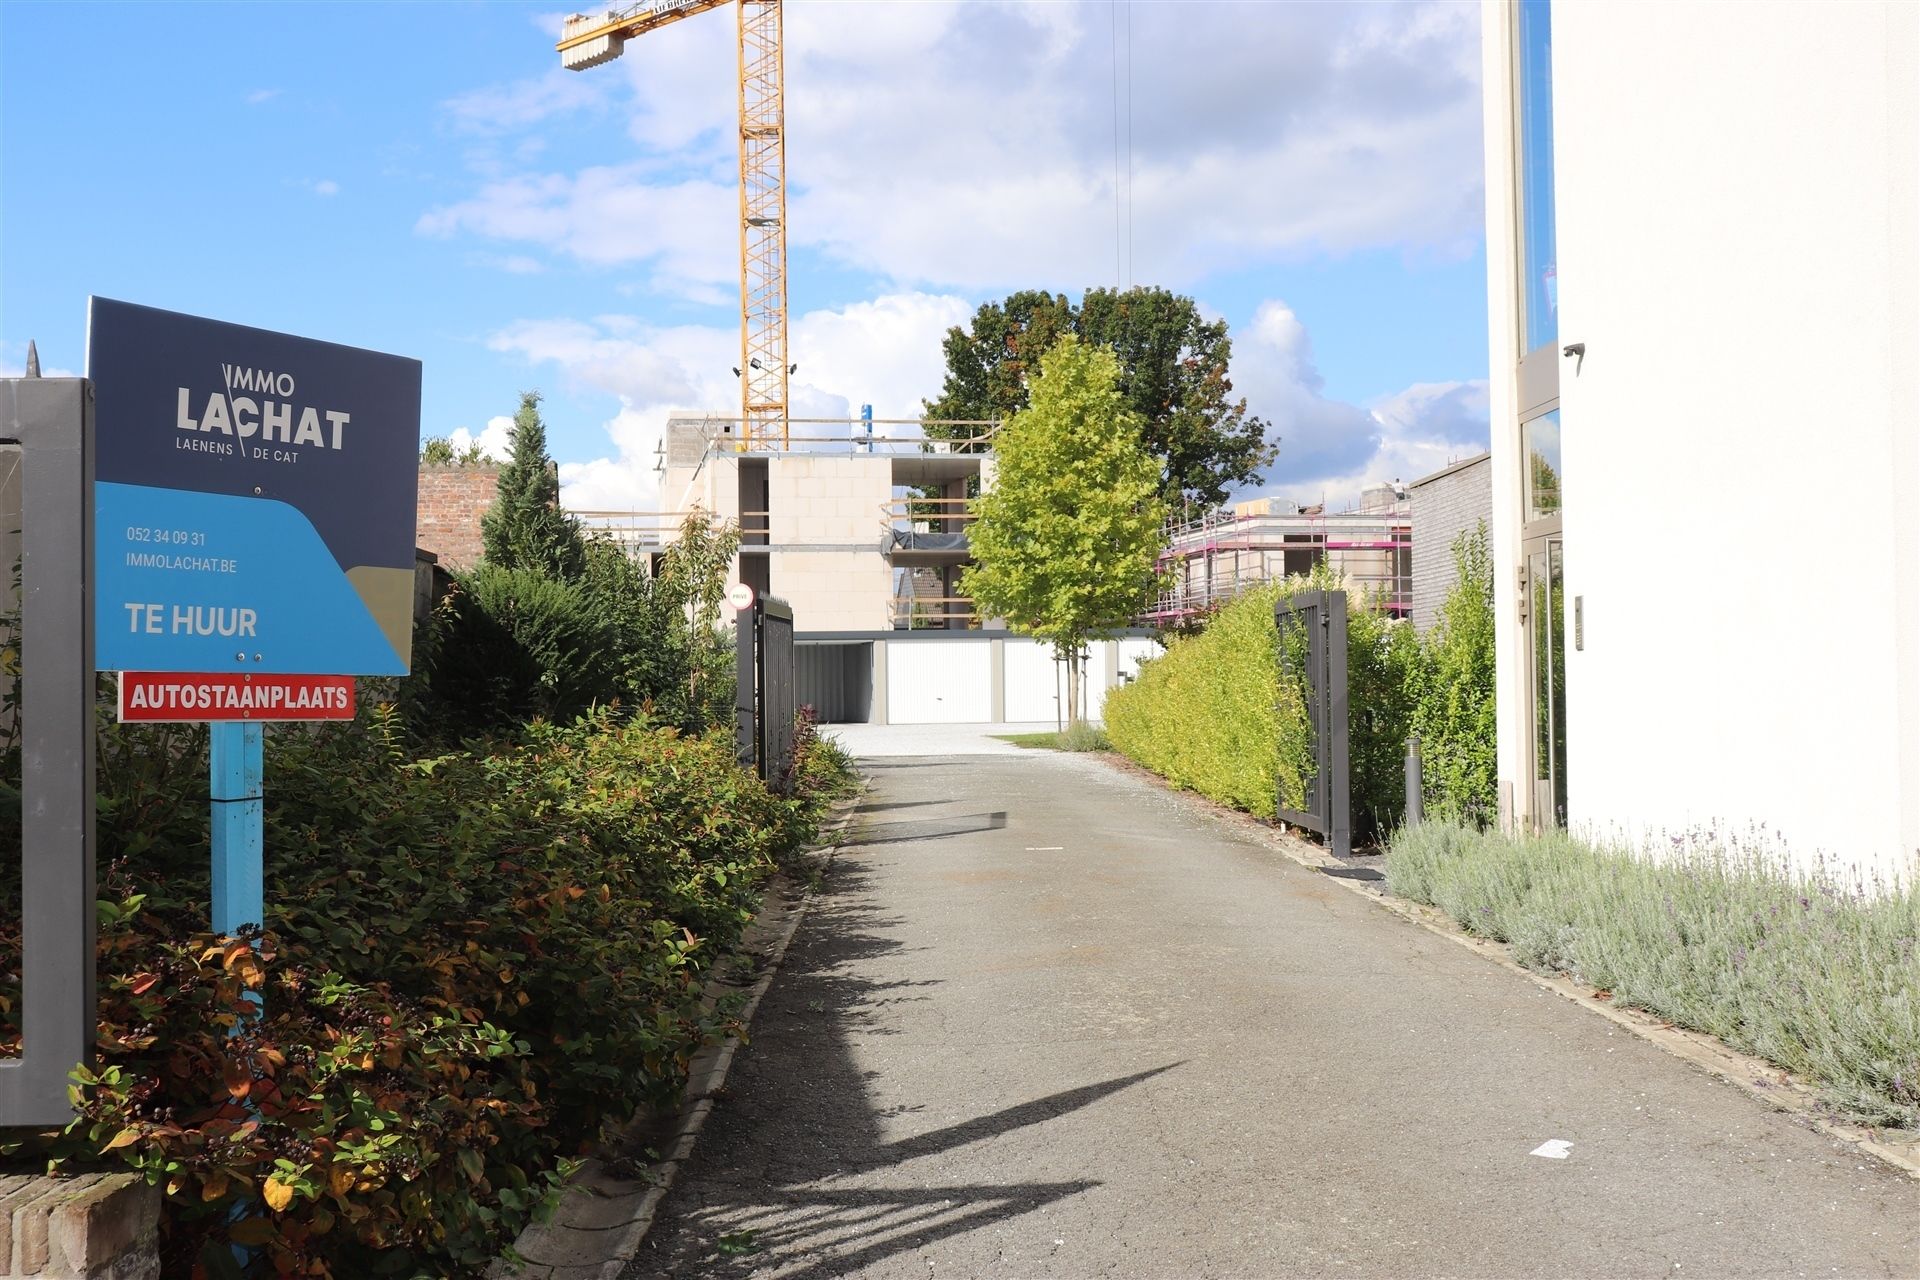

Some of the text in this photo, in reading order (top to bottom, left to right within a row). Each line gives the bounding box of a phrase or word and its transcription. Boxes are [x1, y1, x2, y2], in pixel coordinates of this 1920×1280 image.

[224, 364, 295, 397] IMMO
[177, 387, 351, 450] LACHAT
[176, 437, 299, 464] LAENENS DE CAT
[127, 526, 206, 546] 052 34 09 31
[126, 552, 238, 573] IMMOLACHAT.BE
[124, 603, 257, 637] TE HUUR
[130, 684, 348, 709] AUTOSTAANPLAATS
